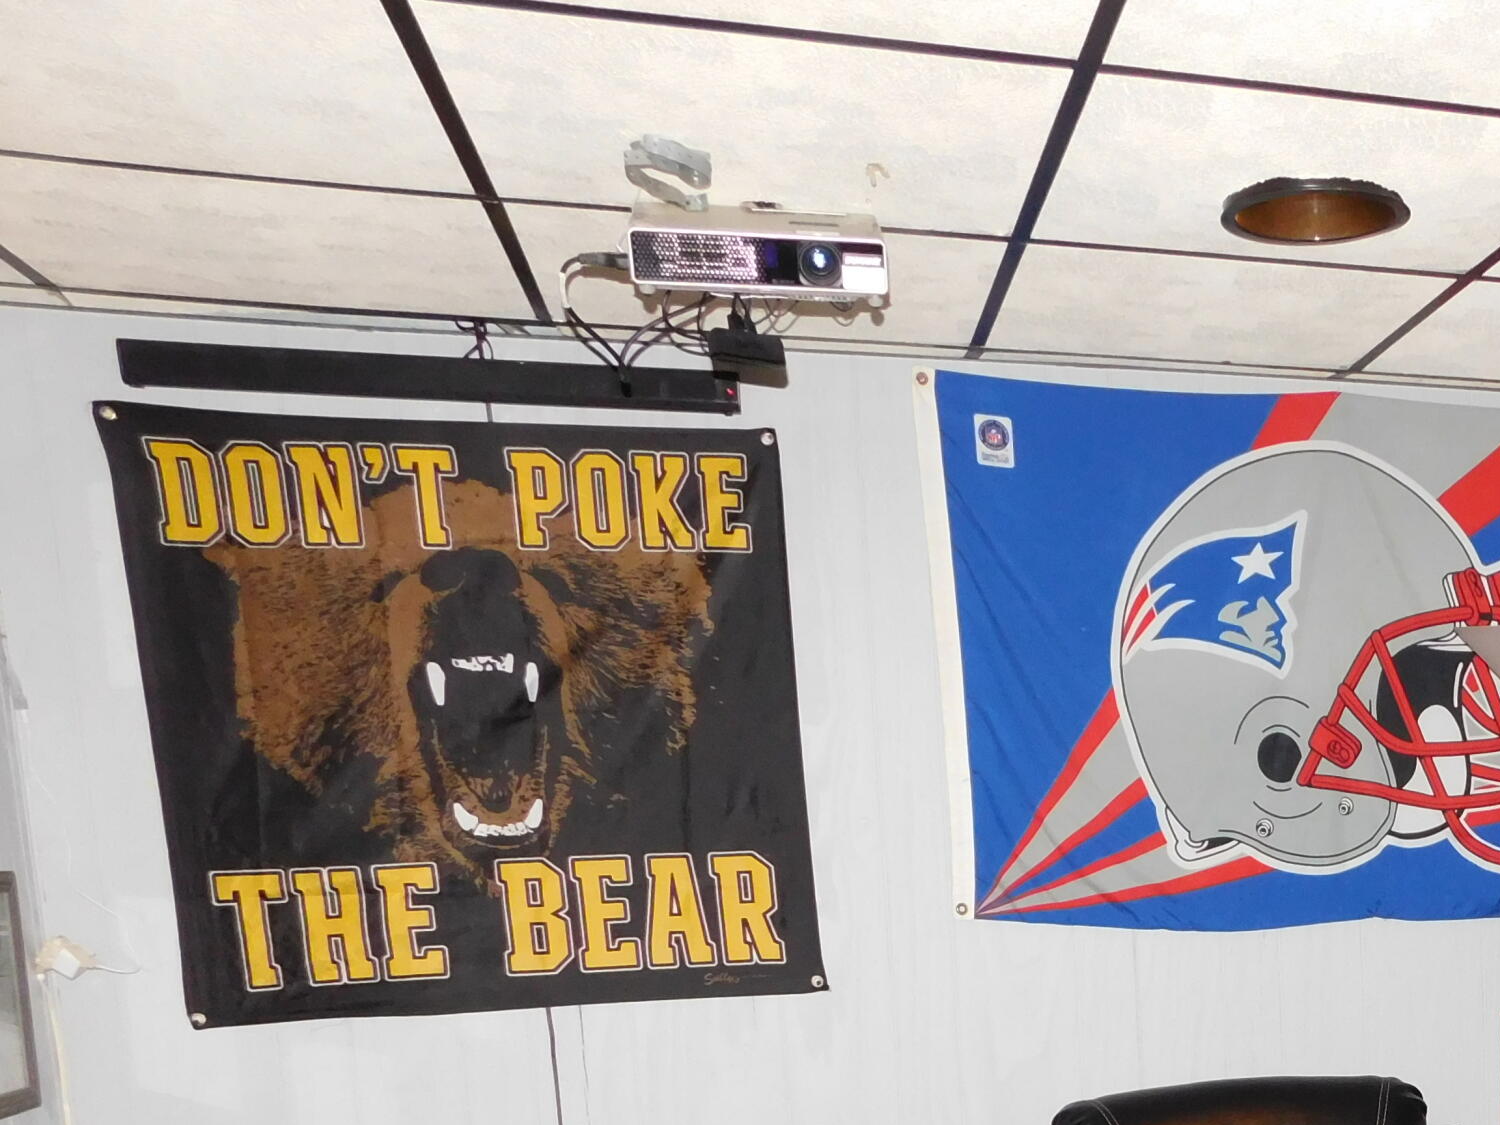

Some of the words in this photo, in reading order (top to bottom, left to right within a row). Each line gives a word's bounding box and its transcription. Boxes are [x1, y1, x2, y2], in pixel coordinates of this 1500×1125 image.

[142, 436, 458, 550] DON'T
[504, 448, 753, 553] POKE
[209, 862, 451, 991] THE
[494, 850, 787, 976] BEAR
